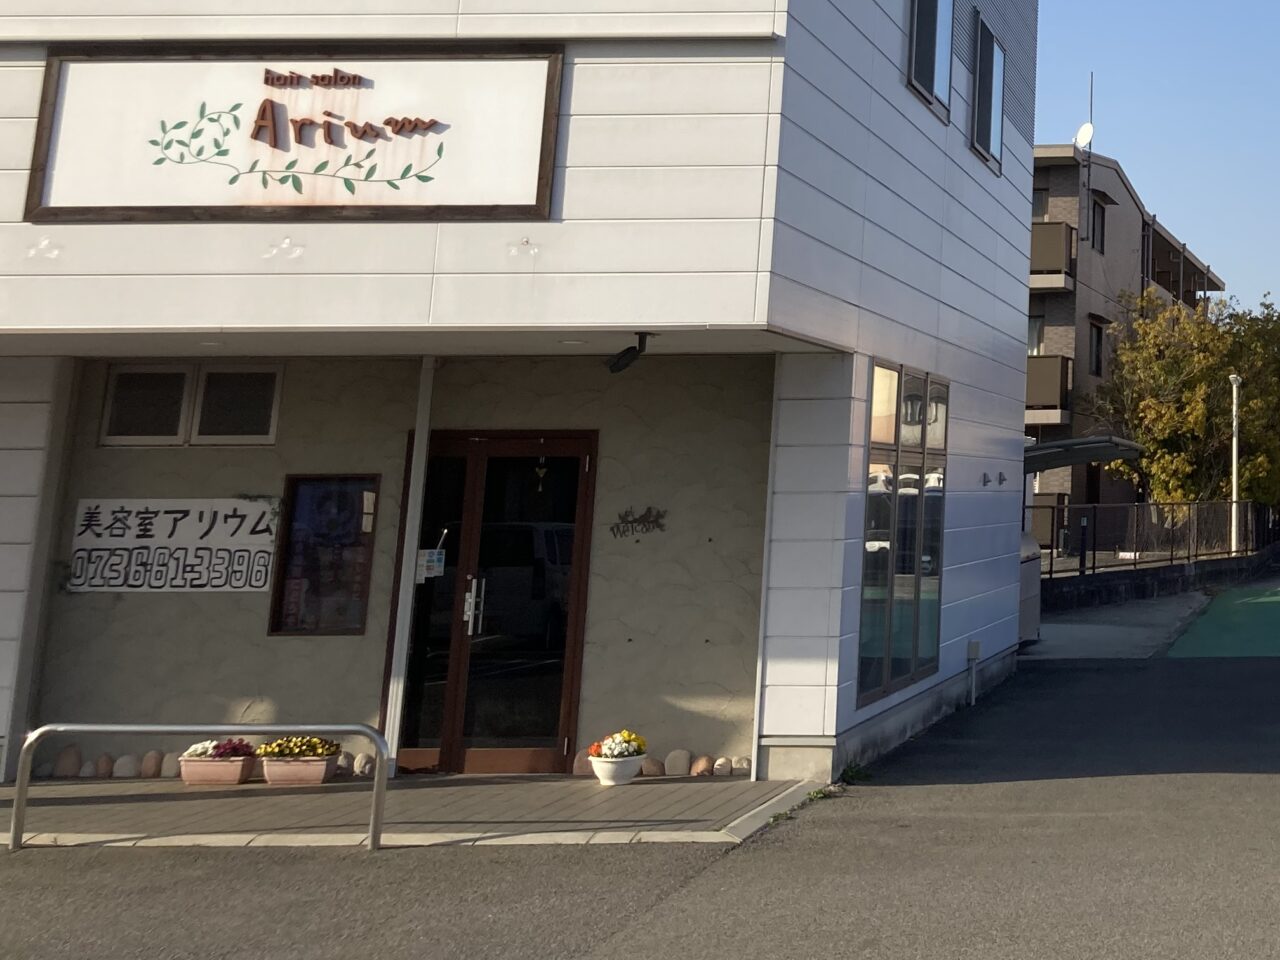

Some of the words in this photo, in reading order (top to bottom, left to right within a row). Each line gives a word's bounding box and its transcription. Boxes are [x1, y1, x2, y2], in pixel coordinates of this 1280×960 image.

[263, 68, 301, 85] hair
[311, 68, 363, 86] salon
[251, 98, 438, 149] Arium
[77, 505, 273, 539] 美容室アリウム
[71, 546, 272, 588] 0736-61-3396
